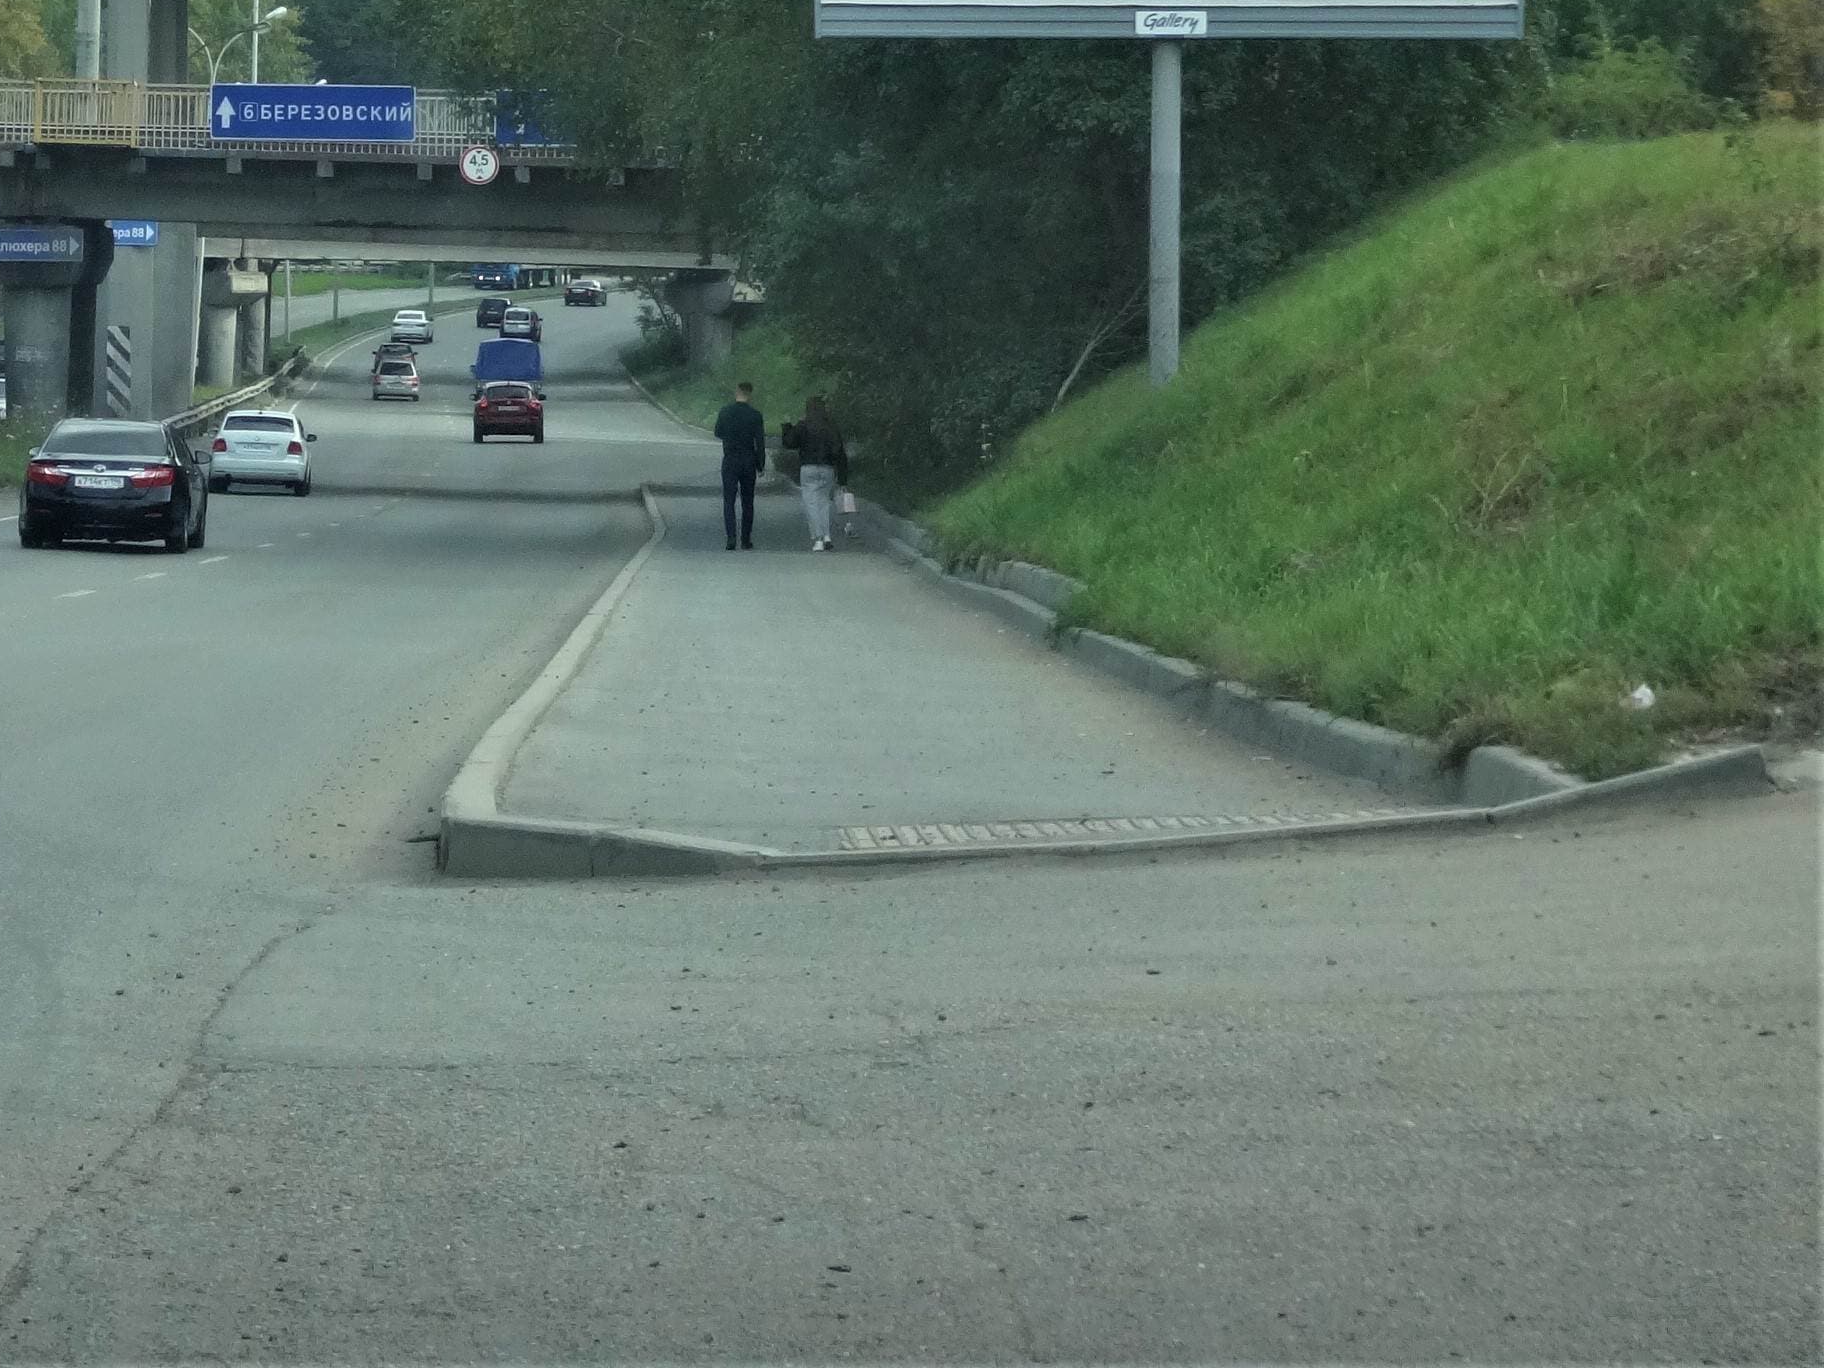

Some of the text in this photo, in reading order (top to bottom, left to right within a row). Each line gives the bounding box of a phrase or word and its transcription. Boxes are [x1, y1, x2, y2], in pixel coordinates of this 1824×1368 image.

[1143, 13, 1199, 33] Gallery
[243, 102, 412, 122] 6 БЕРЕЗОВСКИЙ
[469, 154, 489, 167] 4,5
[131, 227, 145, 238] 88
[0, 240, 67, 255] люхера 88
